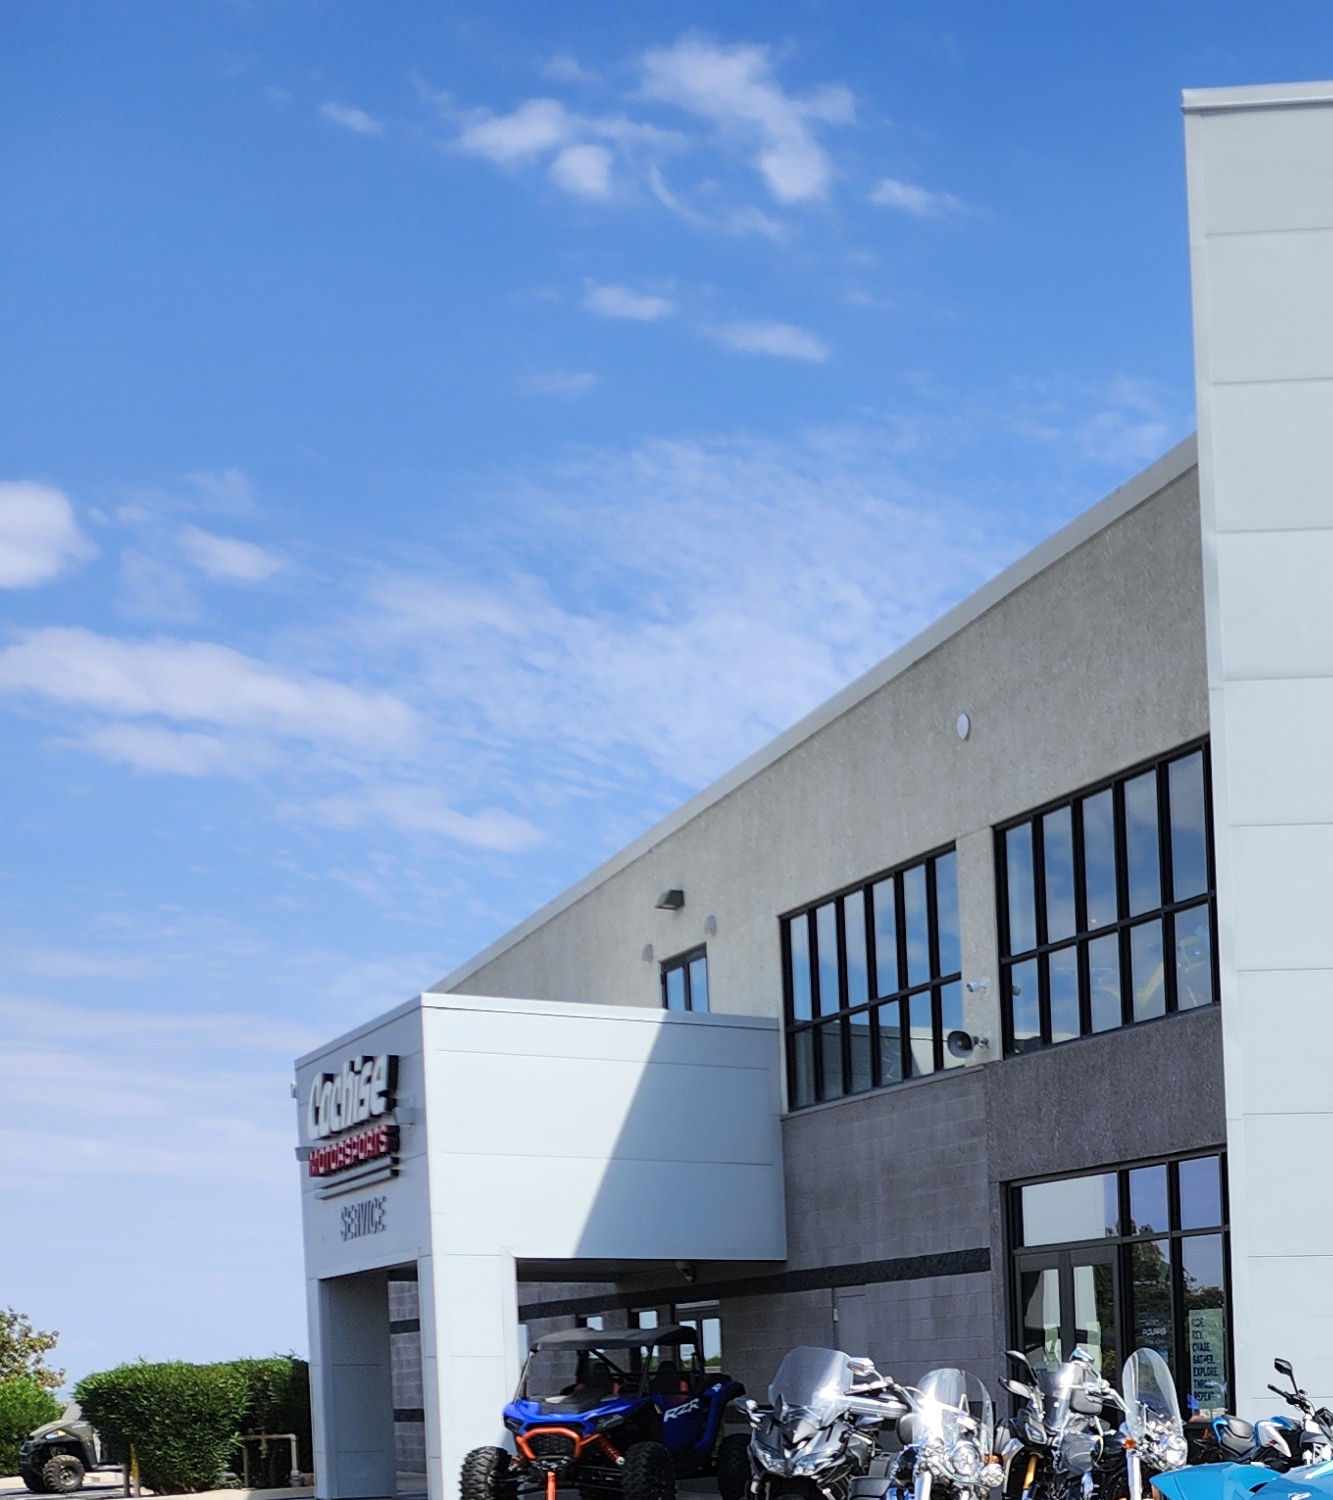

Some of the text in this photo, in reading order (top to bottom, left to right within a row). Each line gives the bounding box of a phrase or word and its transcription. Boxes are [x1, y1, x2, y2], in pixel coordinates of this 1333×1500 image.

[308, 1055, 394, 1140] Cochise
[341, 1196, 387, 1241] SERVICE
[664, 1398, 700, 1422] RZR
